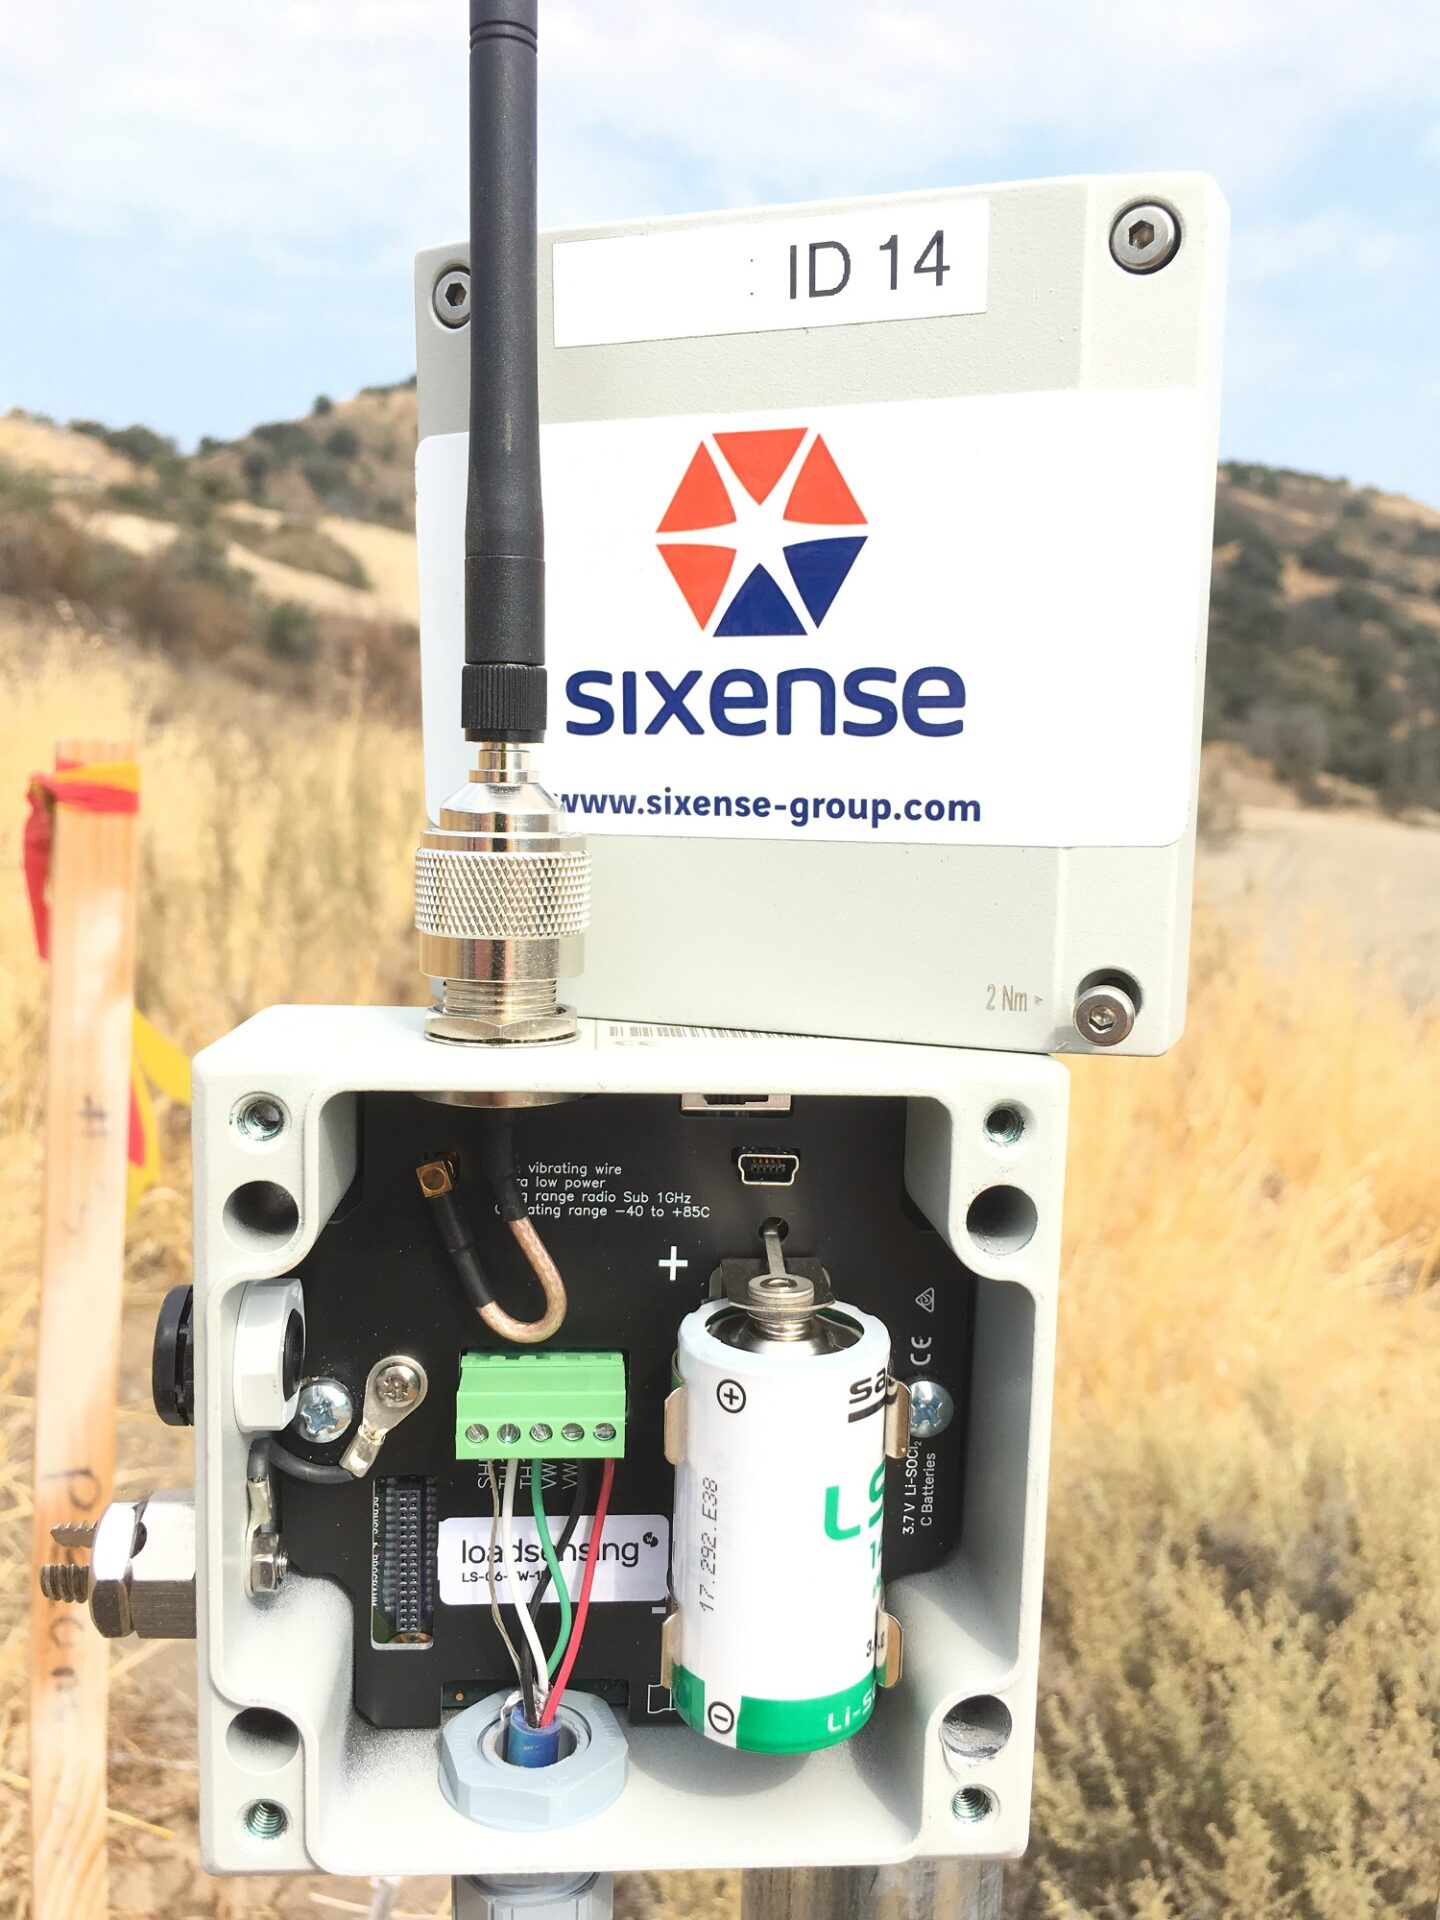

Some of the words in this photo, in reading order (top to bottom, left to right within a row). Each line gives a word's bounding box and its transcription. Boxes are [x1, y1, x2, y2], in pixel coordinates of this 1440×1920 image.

[789, 240, 851, 300] ID
[879, 229, 952, 291] 14
[565, 666, 967, 738] sixense
[557, 787, 982, 829] www.sixense-group.com
[985, 983, 996, 1011] 2
[1002, 984, 1028, 1012] Nm
[528, 1162, 588, 1177] vibrating
[595, 1162, 622, 1175] wire
[535, 1176, 558, 1188] low
[565, 1178, 607, 1190] power
[535, 1192, 575, 1203] range
[581, 1190, 617, 1203] radio
[623, 1191, 649, 1203] Sub
[657, 1192, 692, 1204] 1GHz
[568, 1206, 608, 1218] range
[615, 1205, 644, 1217] -40
[651, 1206, 664, 1218] to
[672, 1206, 711, 1218] +85C
[921, 1452, 936, 1513] Batteries
[903, 1502, 916, 1512] V
[902, 1515, 916, 1535] 3.7
[920, 1516, 933, 1526] C
